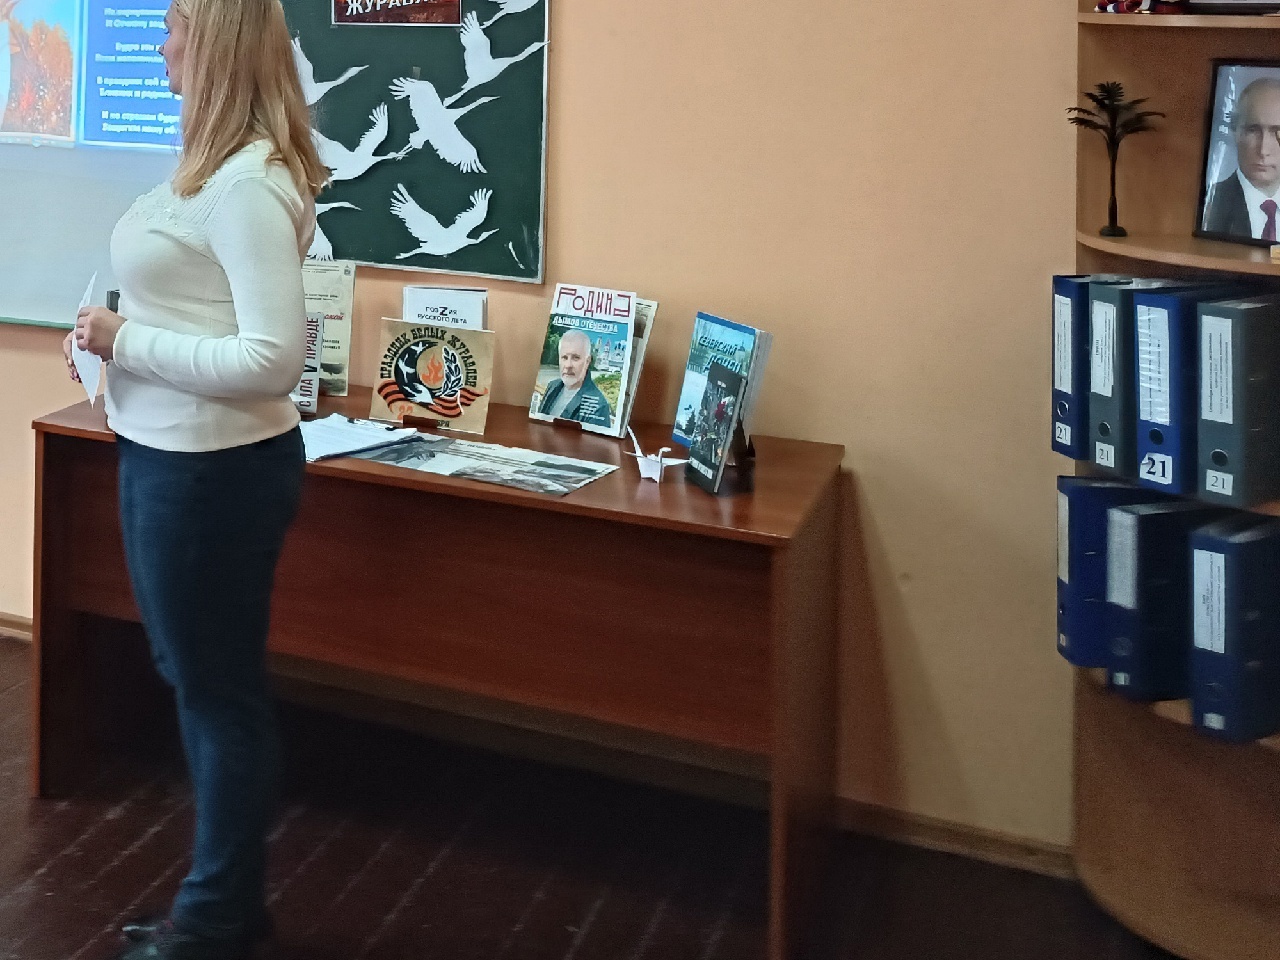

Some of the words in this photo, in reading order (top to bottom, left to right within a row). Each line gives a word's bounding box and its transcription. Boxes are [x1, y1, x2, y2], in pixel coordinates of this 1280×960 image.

[380, 332, 412, 379] ПРАЗДНИК
[410, 326, 448, 341] БЕЛЫХ
[1098, 448, 1109, 461] 21
[1145, 456, 1167, 479] 21
[1211, 474, 1226, 490] 21
